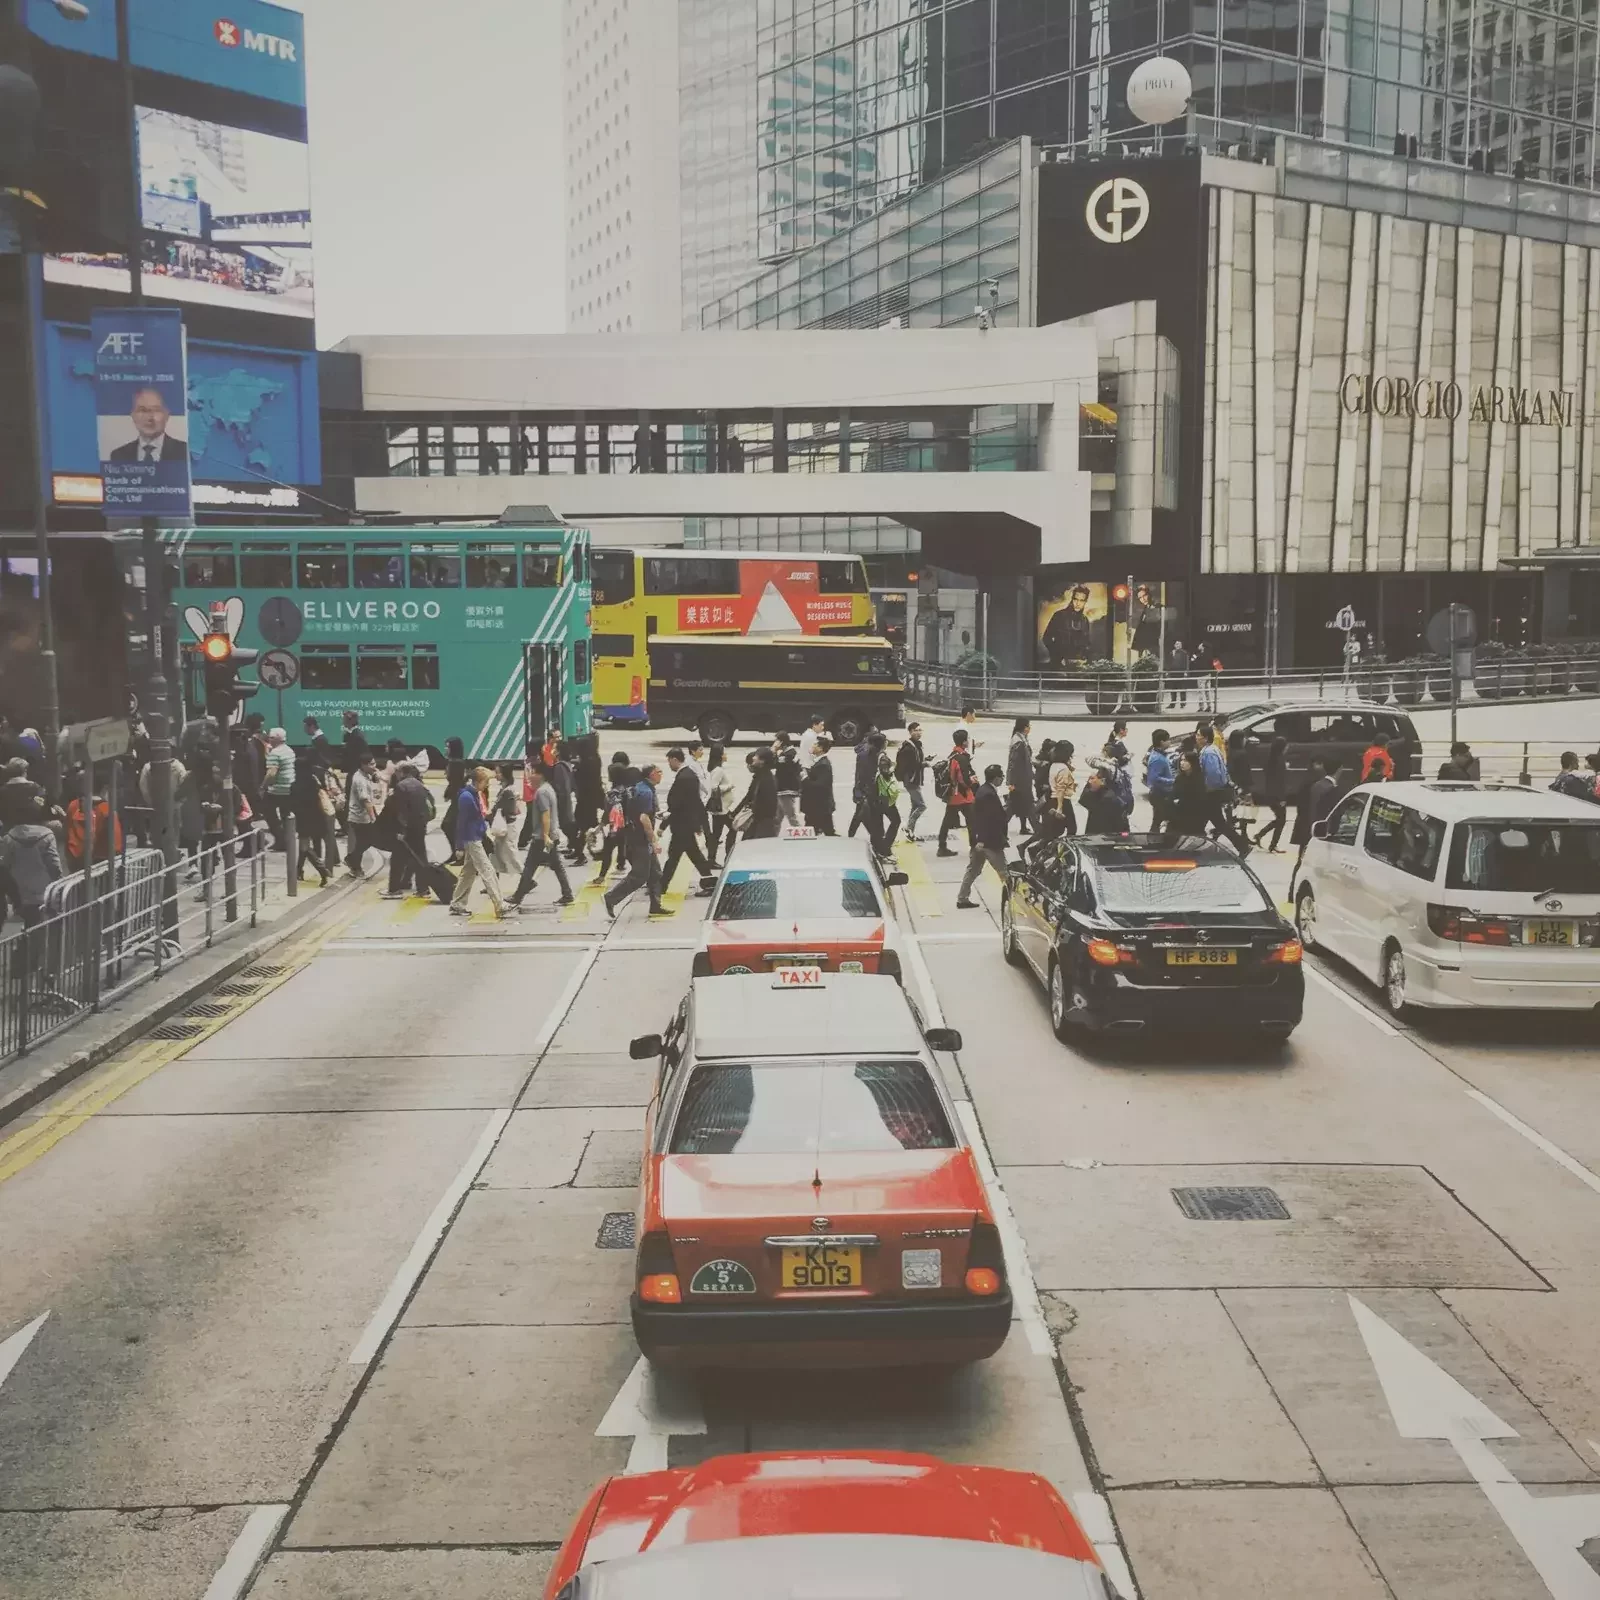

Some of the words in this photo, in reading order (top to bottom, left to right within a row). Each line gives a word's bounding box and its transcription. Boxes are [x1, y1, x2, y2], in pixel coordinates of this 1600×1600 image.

[243, 28, 297, 63] MTR
[97, 332, 144, 354] AFF
[1340, 373, 1463, 421] GIORGIO
[1469, 383, 1574, 428] ARMANI
[104, 476, 129, 485] Bank
[130, 476, 142, 485] of
[104, 485, 186, 494] Communications
[302, 600, 441, 619] ELIVEROO
[806, 601, 834, 610] WIRELESS
[835, 601, 853, 609] MUSIC
[807, 612, 835, 621] DESERVES
[836, 611, 852, 620] BOSE
[299, 700, 322, 708] YOUR
[324, 700, 369, 708] FAVOURITE
[371, 700, 431, 708] RESTAURANTS
[306, 710, 327, 718] NOW
[376, 710, 387, 718] 32
[786, 828, 813, 837] TAXI
[1534, 931, 1568, 944] 1642
[1175, 950, 1194, 963] HF
[1199, 950, 1229, 963] 888
[780, 970, 820, 984] TAXI
[804, 1245, 839, 1266] KC
[709, 1262, 739, 1273] TAXI
[717, 1270, 731, 1284] 5
[793, 1265, 852, 1286] 9013
[702, 1283, 745, 1291] SEATS
